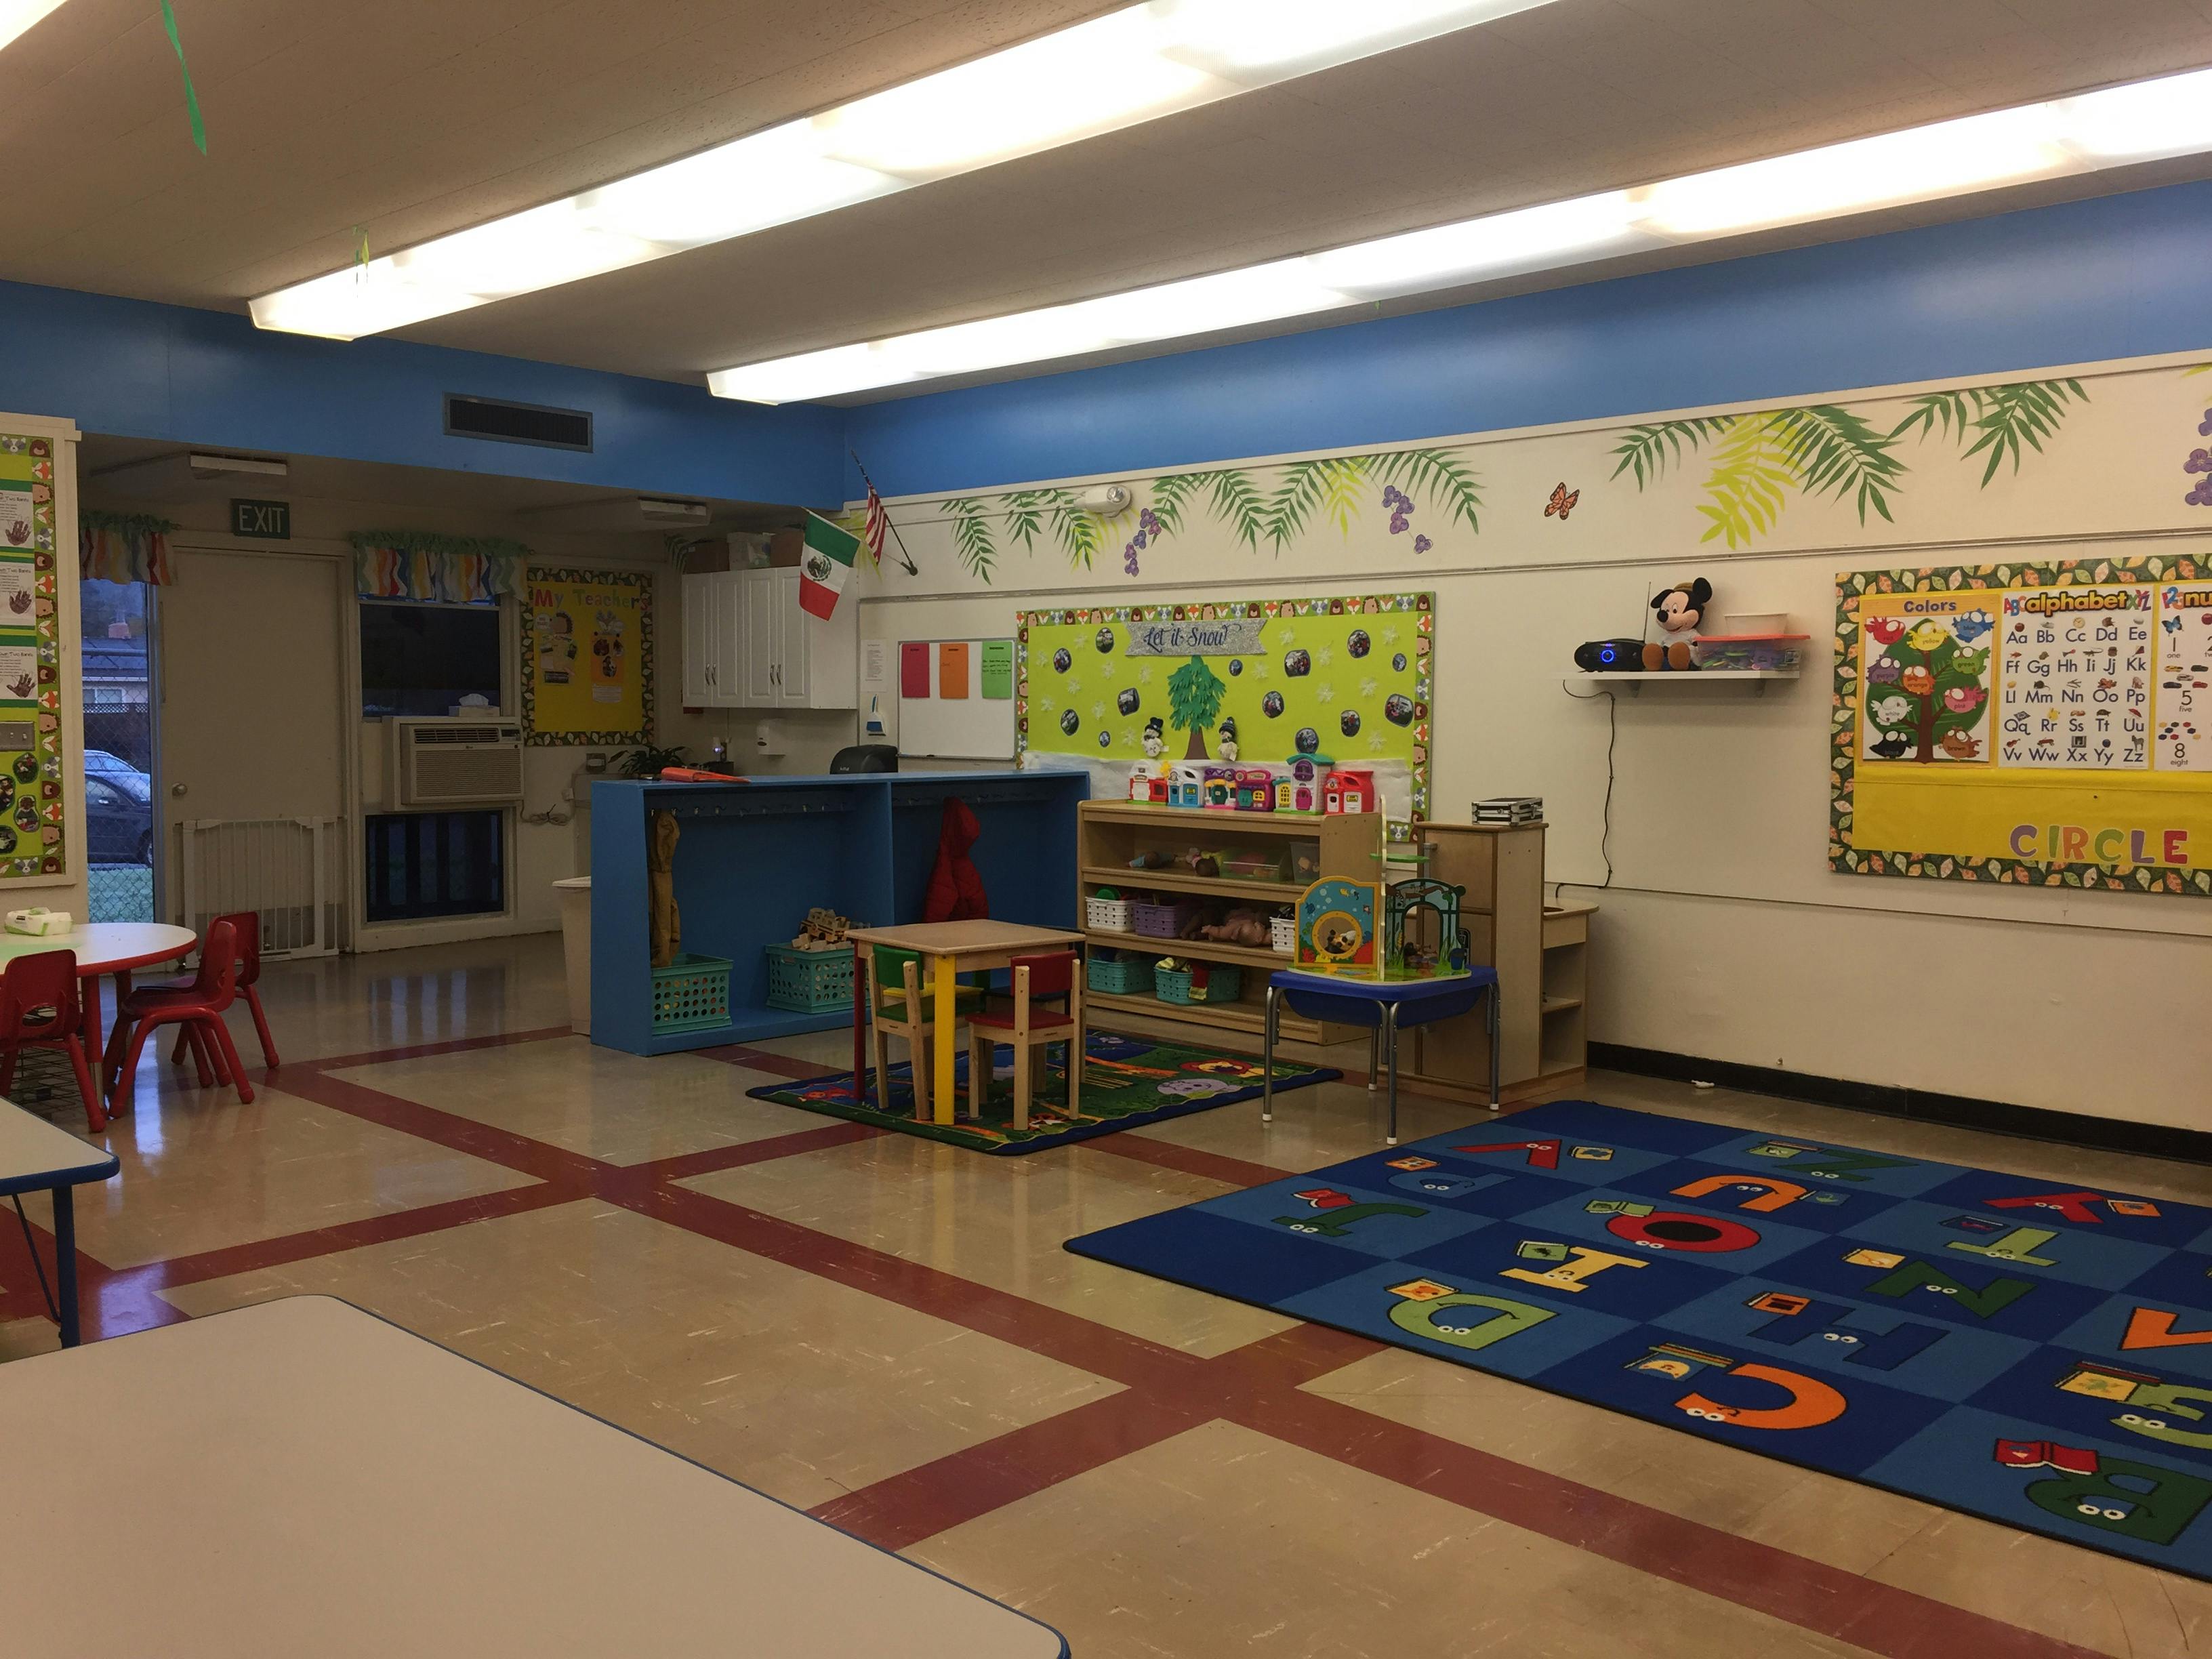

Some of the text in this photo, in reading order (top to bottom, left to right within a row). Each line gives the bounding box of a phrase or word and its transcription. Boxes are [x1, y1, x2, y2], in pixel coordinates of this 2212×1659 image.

[239, 505, 284, 533] EXIT
[535, 589, 650, 610] My Teachers
[1904, 600, 1957, 613] Colors
[2003, 590, 2151, 617] ABC alphabet XYZ
[1143, 626, 1172, 653] Let
[1171, 623, 1184, 646] it
[2006, 627, 2147, 644] Aa Bb Cc Dd Ee
[2006, 658, 2146, 677] Ff Gg Hh Ii Jj Kk
[2006, 689, 2146, 706] Ll Mm Nn Oo Pp
[2181, 691, 2192, 705] 5
[2004, 718, 2144, 735] Qq Rr Ss Tt Uu
[2003, 747, 2144, 766] Vv Ww Xx Yy Zz
[2174, 743, 2185, 758] 8
[2009, 824, 2188, 865] CIRCLE
[1669, 1174, 1809, 1212] U
[1605, 1211, 1761, 1252] O
[1945, 1225, 2063, 1267] T
[1864, 1259, 2037, 1319] N
[1387, 1292, 1559, 1350] D
[1673, 1361, 1848, 1431] C
